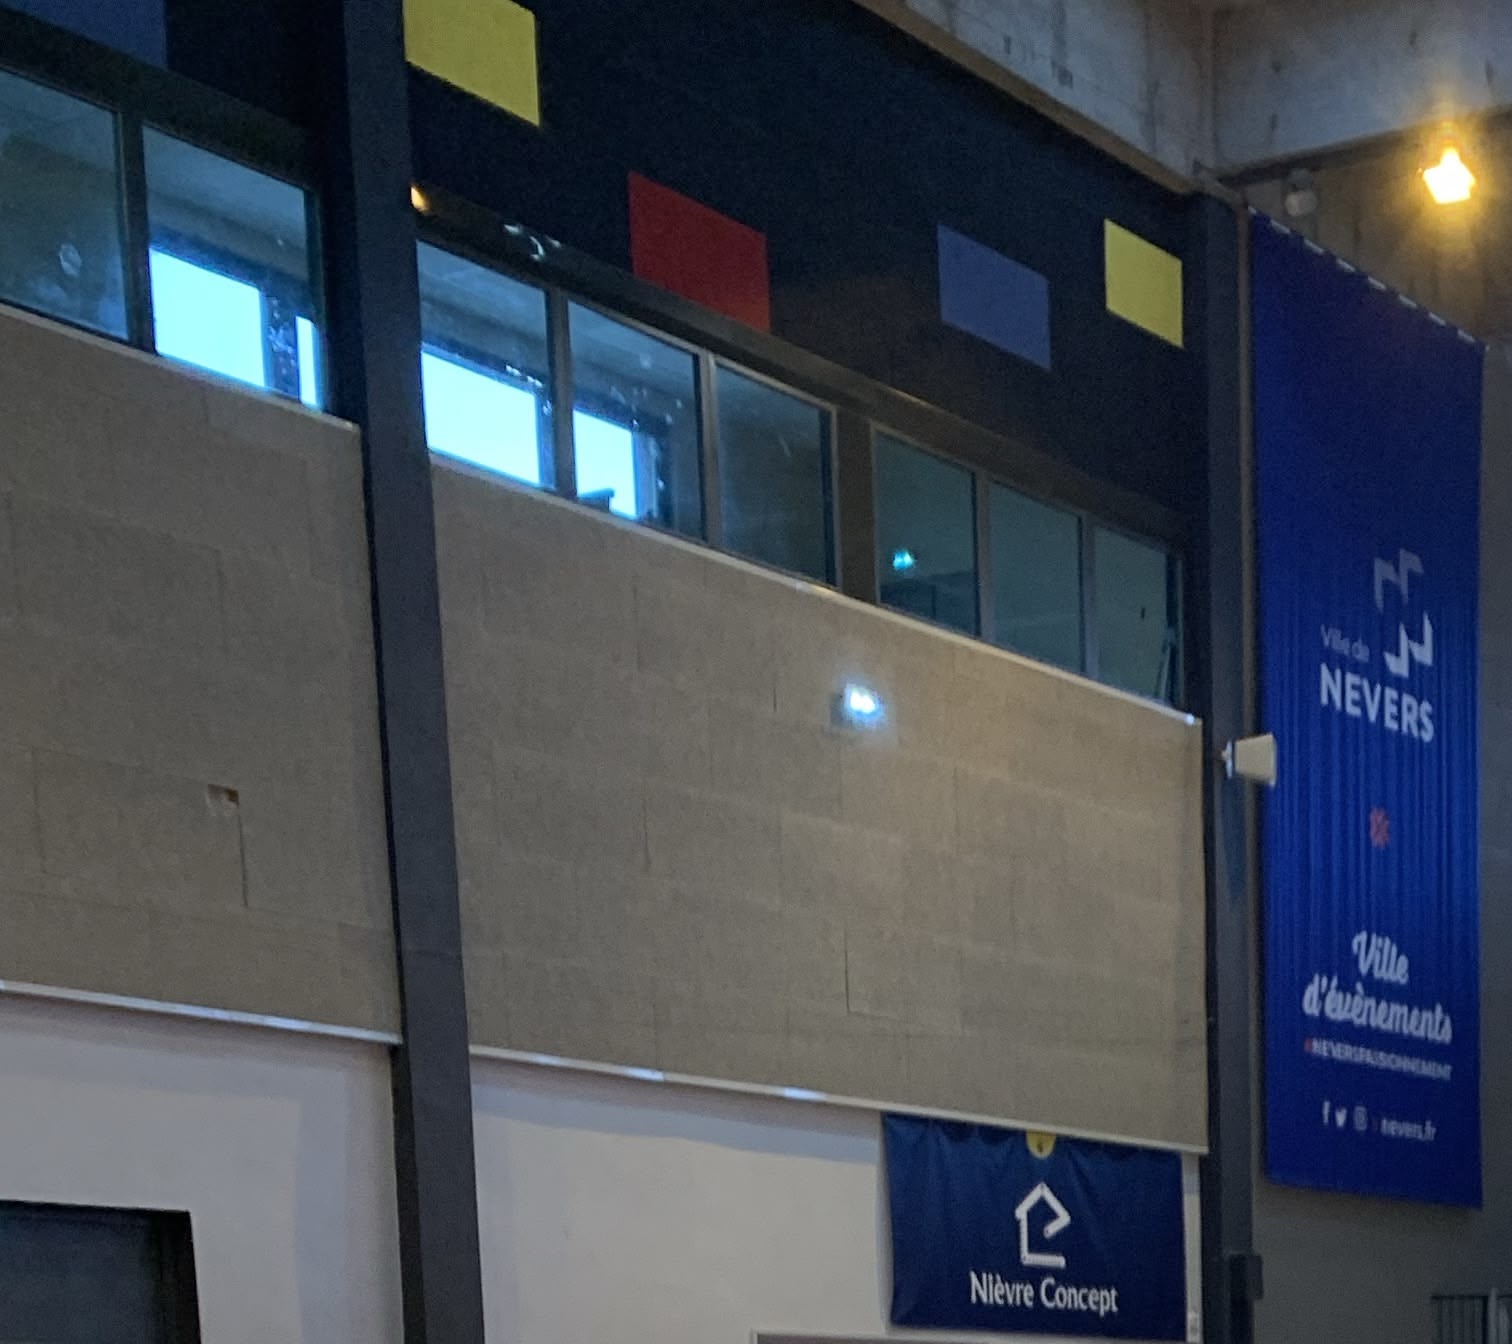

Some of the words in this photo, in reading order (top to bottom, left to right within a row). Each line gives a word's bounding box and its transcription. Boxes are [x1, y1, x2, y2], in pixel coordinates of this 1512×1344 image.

[1320, 662, 1434, 743] NEVERS
[1351, 930, 1410, 985] Ville
[970, 1271, 1034, 1307] Nièvre
[1041, 1276, 1119, 1317] Concept
